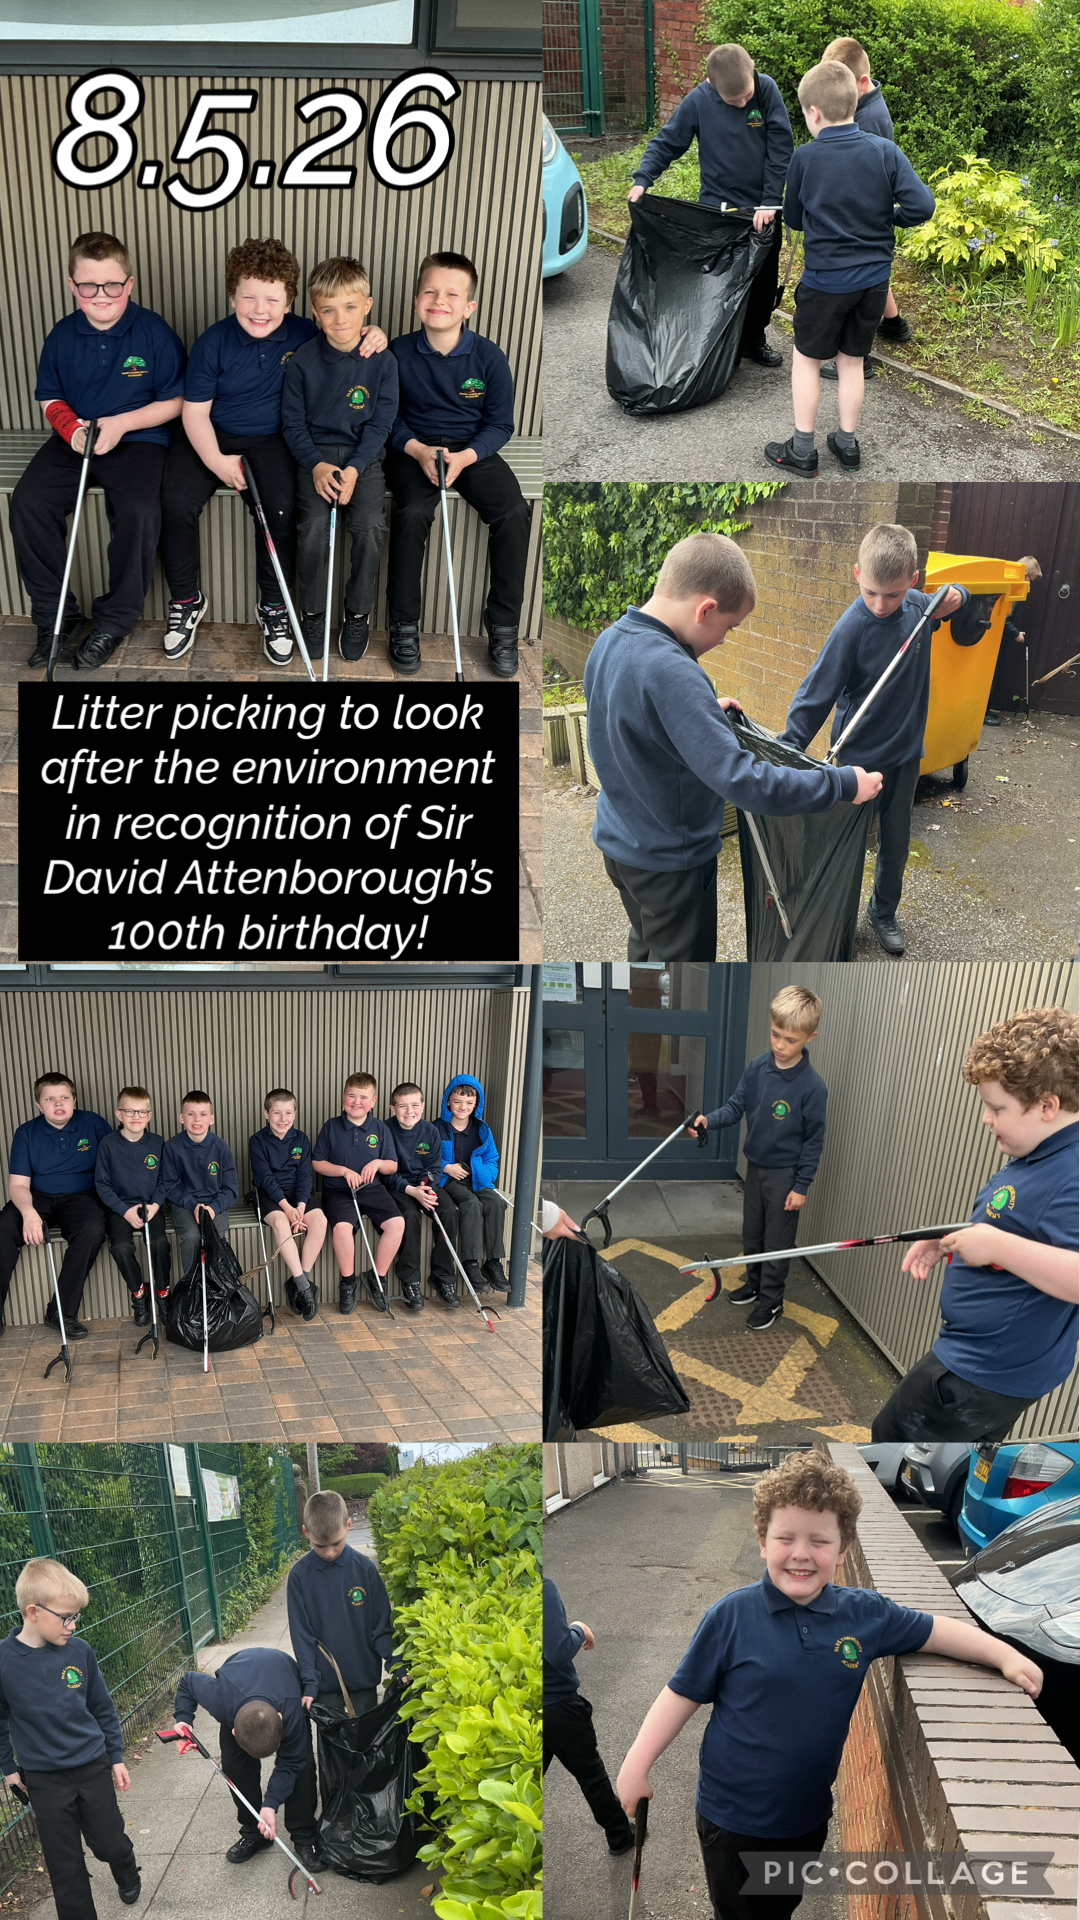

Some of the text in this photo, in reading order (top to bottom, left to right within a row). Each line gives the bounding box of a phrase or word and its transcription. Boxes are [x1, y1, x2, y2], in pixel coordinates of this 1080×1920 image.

[833, 1636, 862, 1653] PARK COMMUNITY
[841, 1659, 860, 1669] ACADEMY
